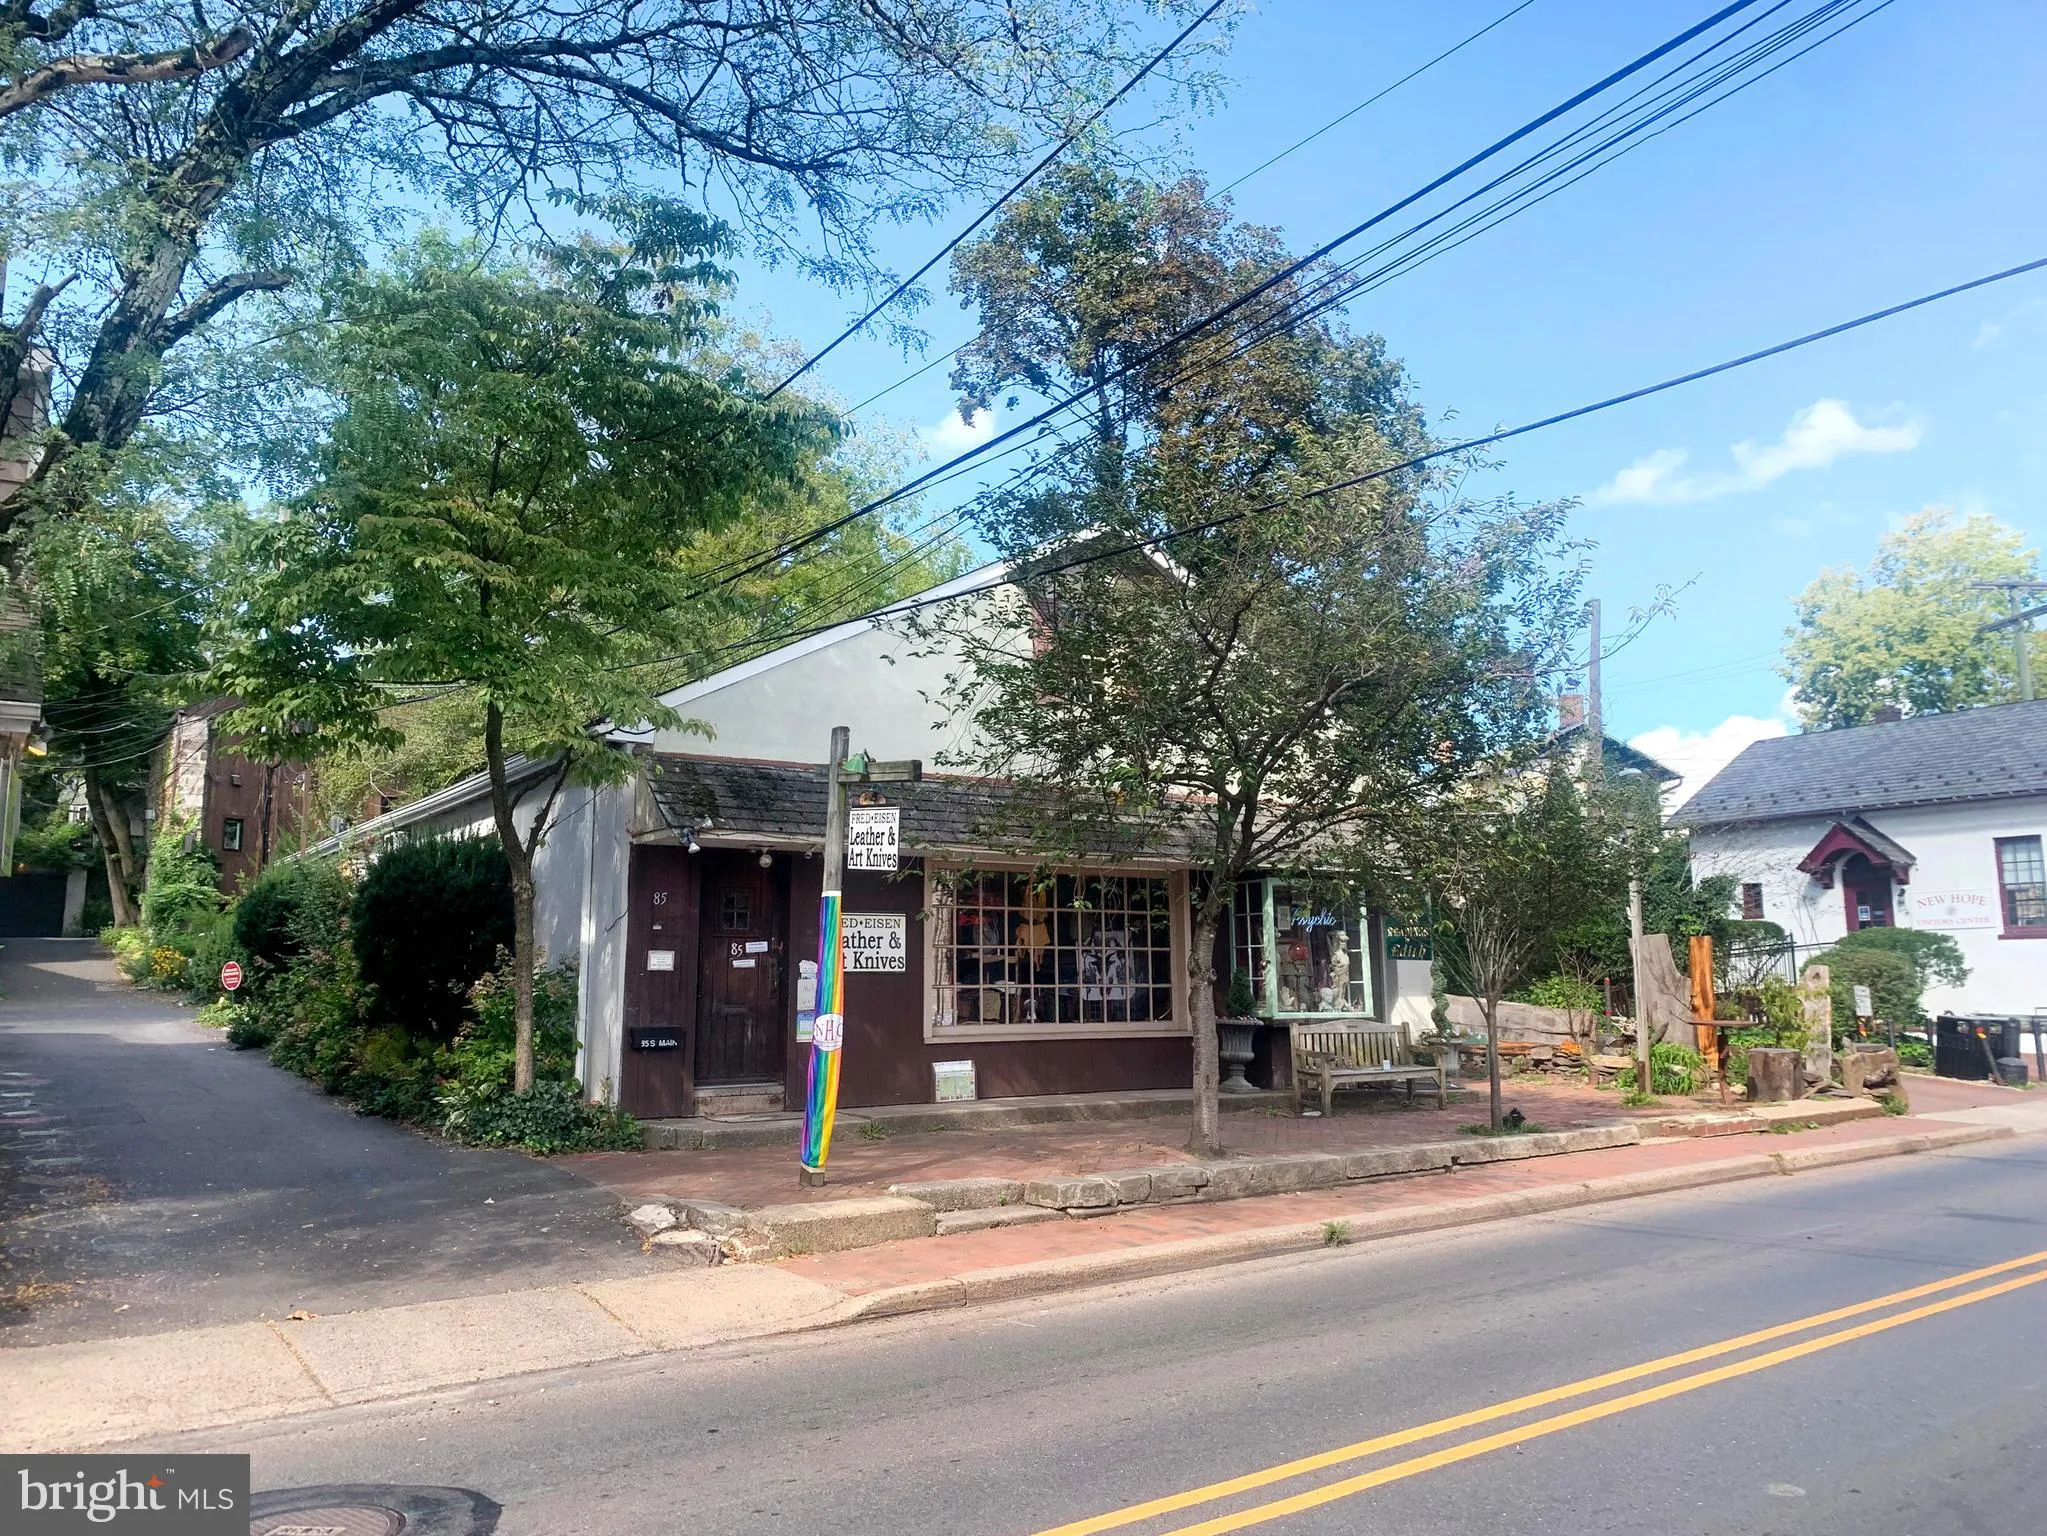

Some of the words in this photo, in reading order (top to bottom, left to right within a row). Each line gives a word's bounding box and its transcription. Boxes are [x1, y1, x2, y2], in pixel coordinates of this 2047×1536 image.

[850, 826, 885, 846] Leather
[887, 826, 896, 846] &
[848, 848, 863, 867] Art
[866, 848, 897, 868] Knives
[653, 892, 668, 905] 85
[1916, 894, 1947, 910] NEW
[1951, 893, 1987, 907] HOPE
[842, 930, 884, 950] ather
[888, 931, 902, 950] &
[730, 942, 744, 957] 85
[852, 950, 905, 970] Knives
[658, 1039, 678, 1048] MAIN
